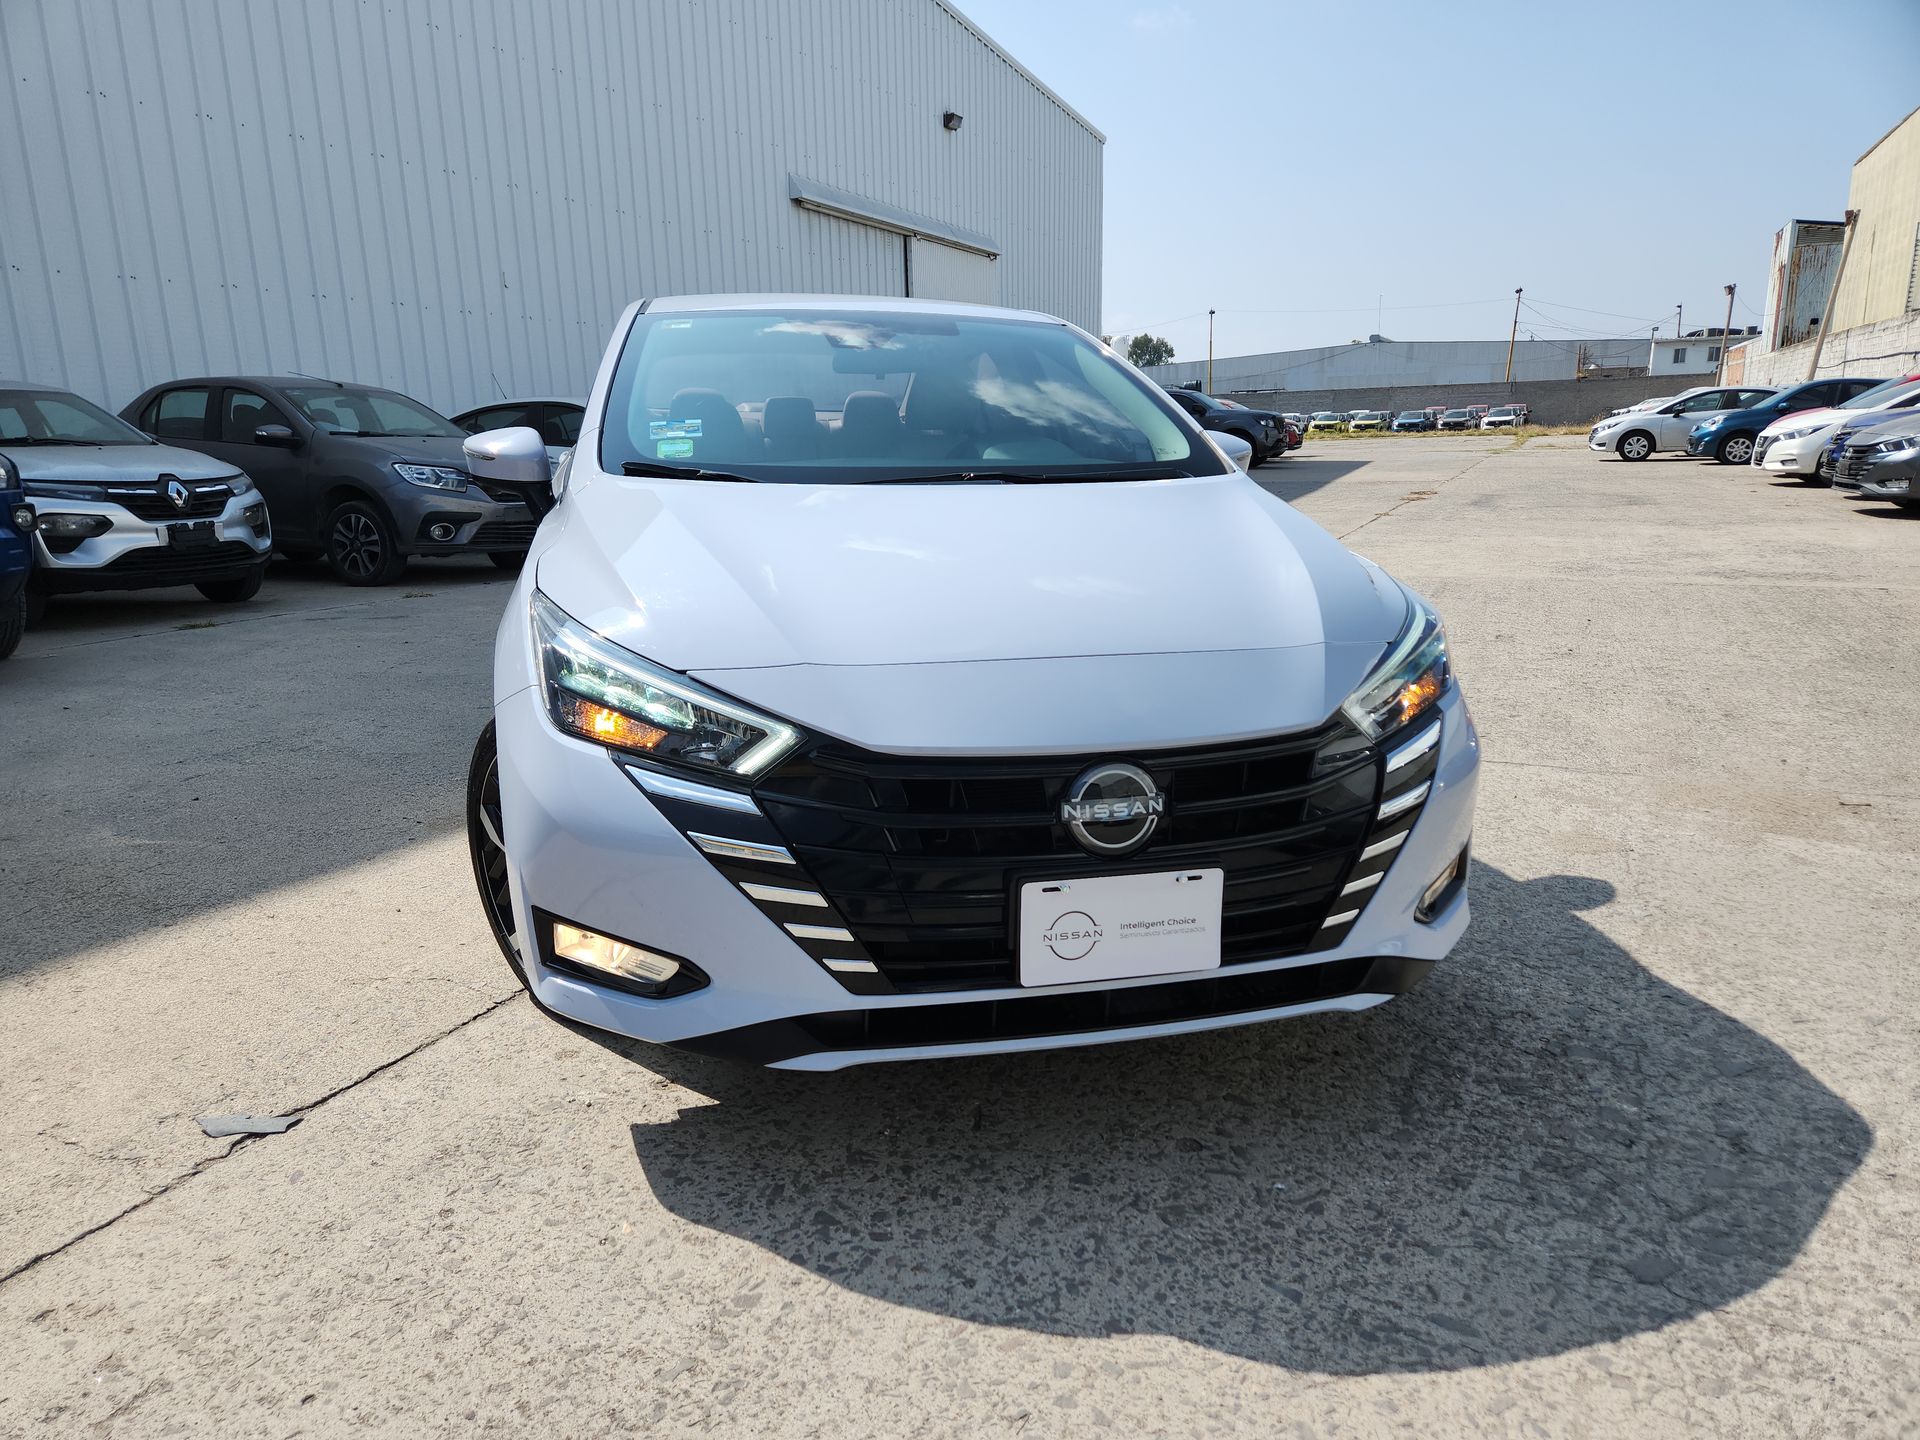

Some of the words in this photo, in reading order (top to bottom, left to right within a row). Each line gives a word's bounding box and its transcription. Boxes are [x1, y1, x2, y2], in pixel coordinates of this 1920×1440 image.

[1063, 798, 1163, 819] NISSAN
[1120, 919, 1165, 930] Intelligent
[1167, 917, 1197, 926] Choice
[1043, 929, 1103, 942] NISSAN
